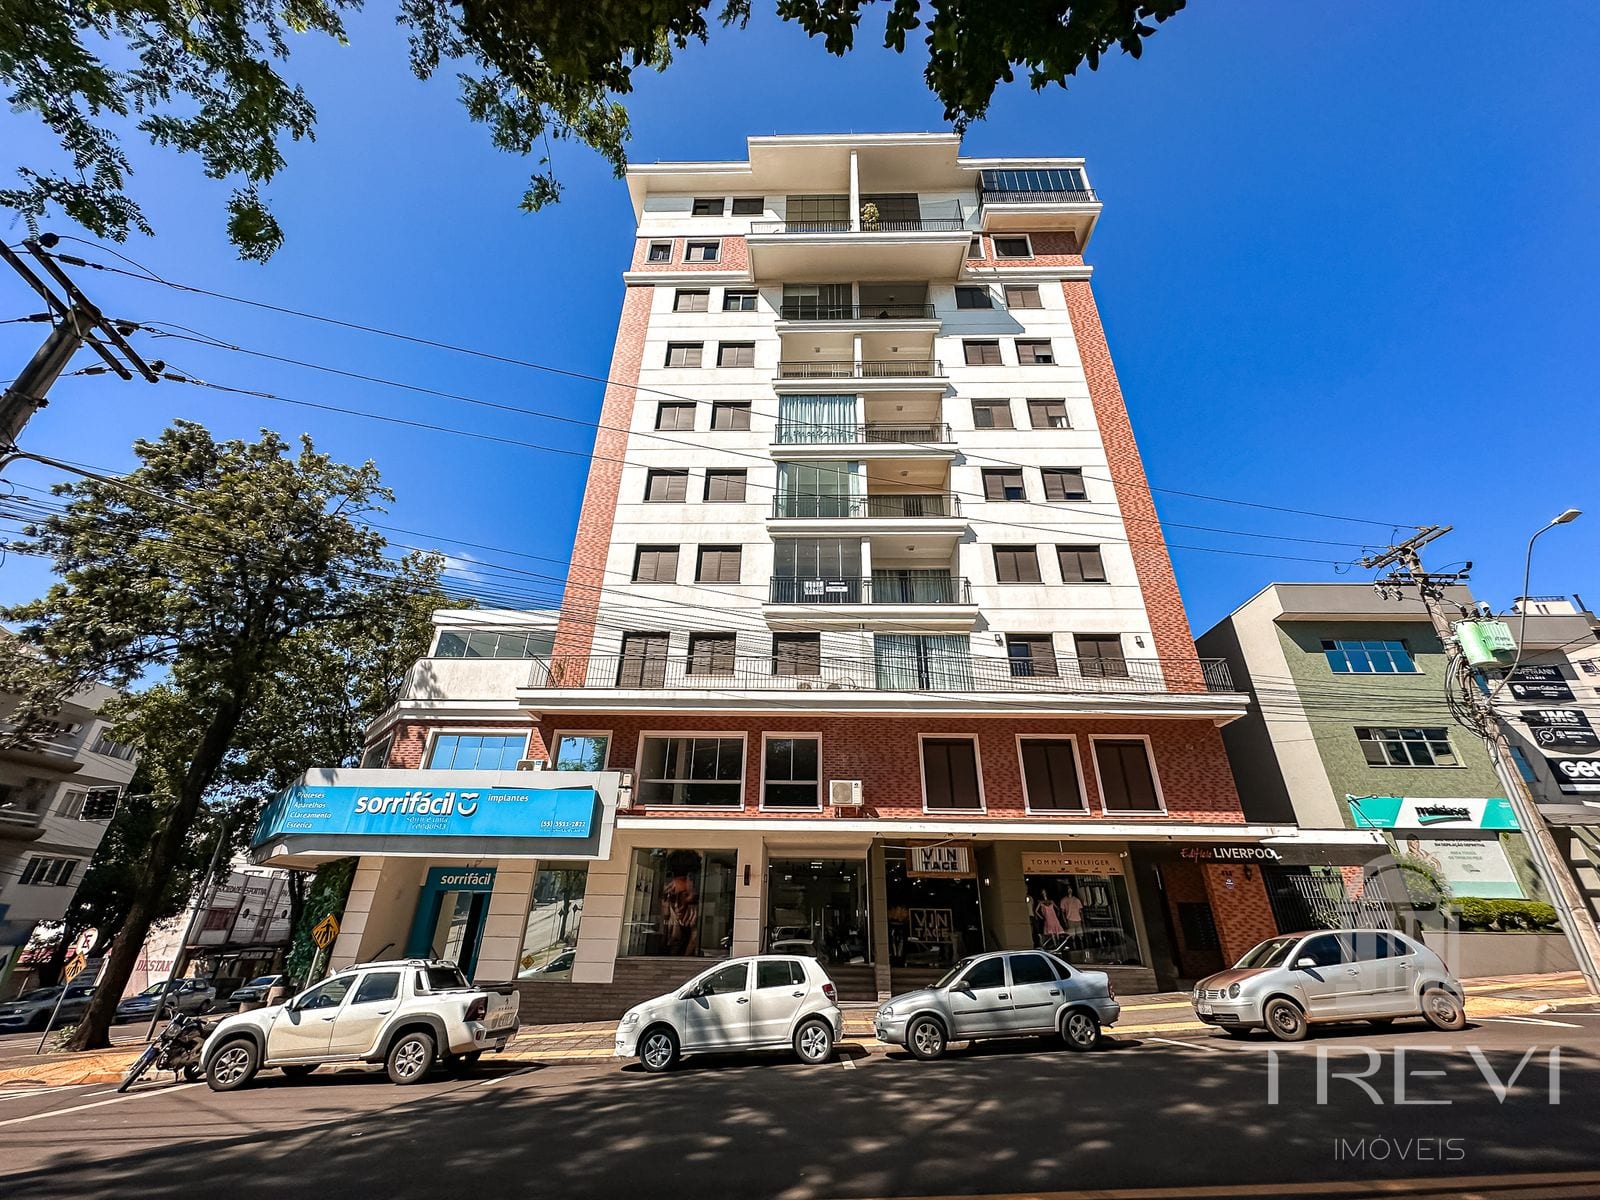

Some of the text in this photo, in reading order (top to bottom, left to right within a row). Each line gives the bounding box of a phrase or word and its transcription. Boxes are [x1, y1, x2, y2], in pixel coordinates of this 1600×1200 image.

[354, 790, 456, 816] sorrifácil
[487, 793, 529, 803] implantes
[294, 801, 326, 809] Aparelhos
[921, 847, 957, 861] VIN
[1213, 847, 1283, 860] LIVERPOOL
[922, 861, 958, 871] TAGE
[1072, 859, 1111, 867] HILFIGER
[440, 872, 492, 885] sorrifácil
[914, 911, 949, 928] VIN
[135, 959, 174, 972] DESTAK
